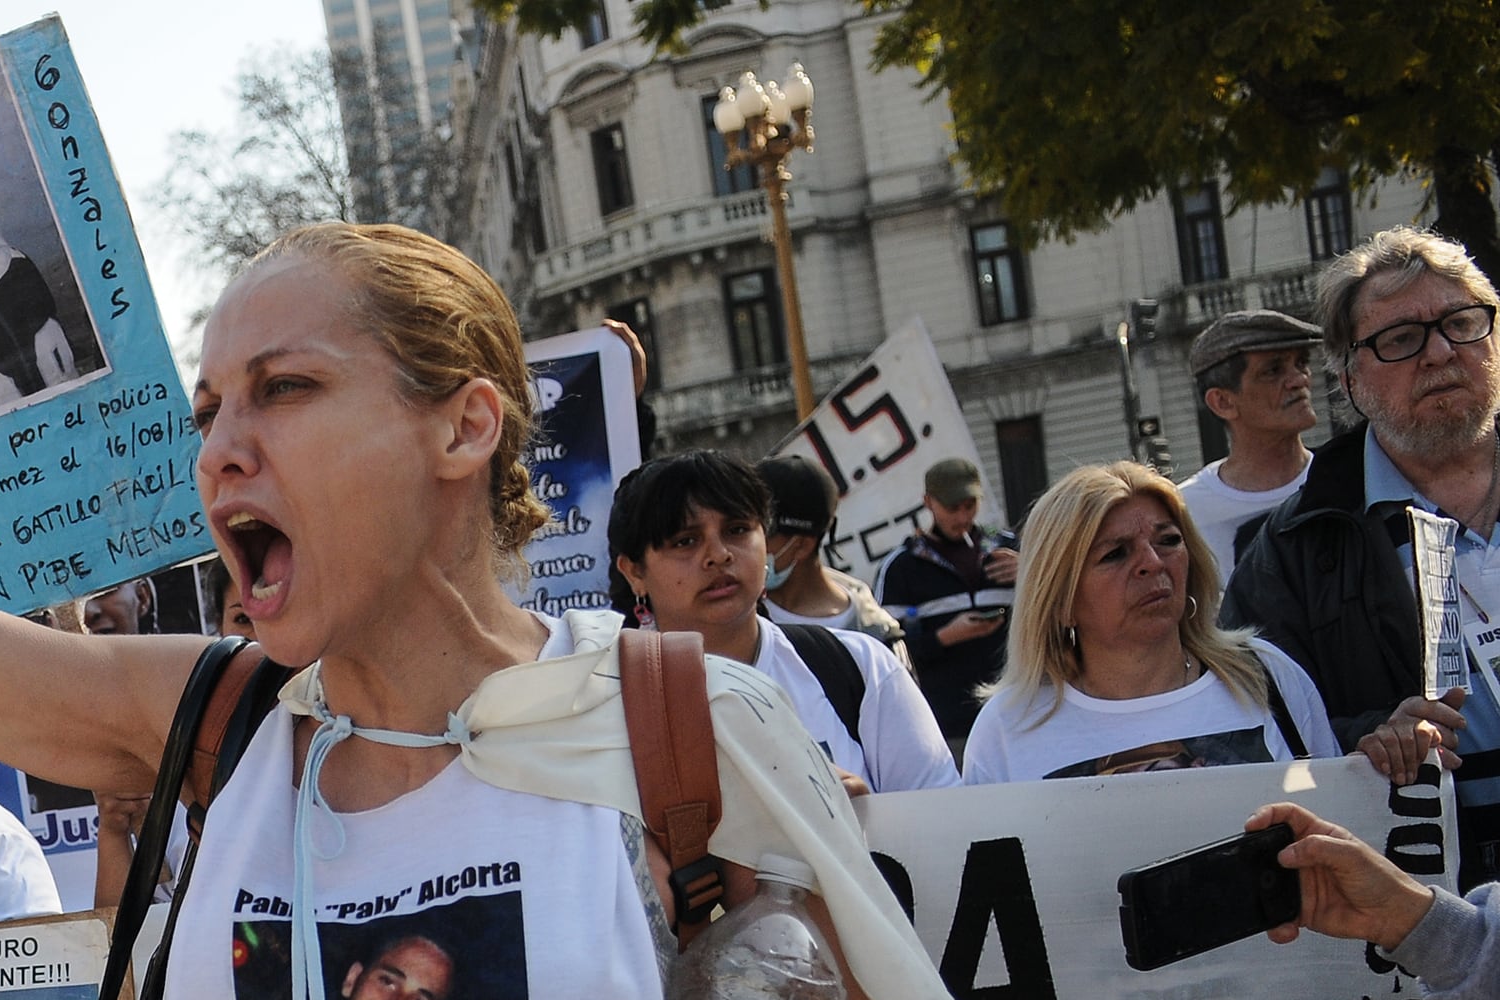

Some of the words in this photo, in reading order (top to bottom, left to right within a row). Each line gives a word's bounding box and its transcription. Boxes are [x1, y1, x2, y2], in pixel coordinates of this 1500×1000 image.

[8, 422, 50, 458] por
[64, 408, 86, 430] el
[60, 447, 82, 473] el
[416, 860, 522, 906] Alcorta
